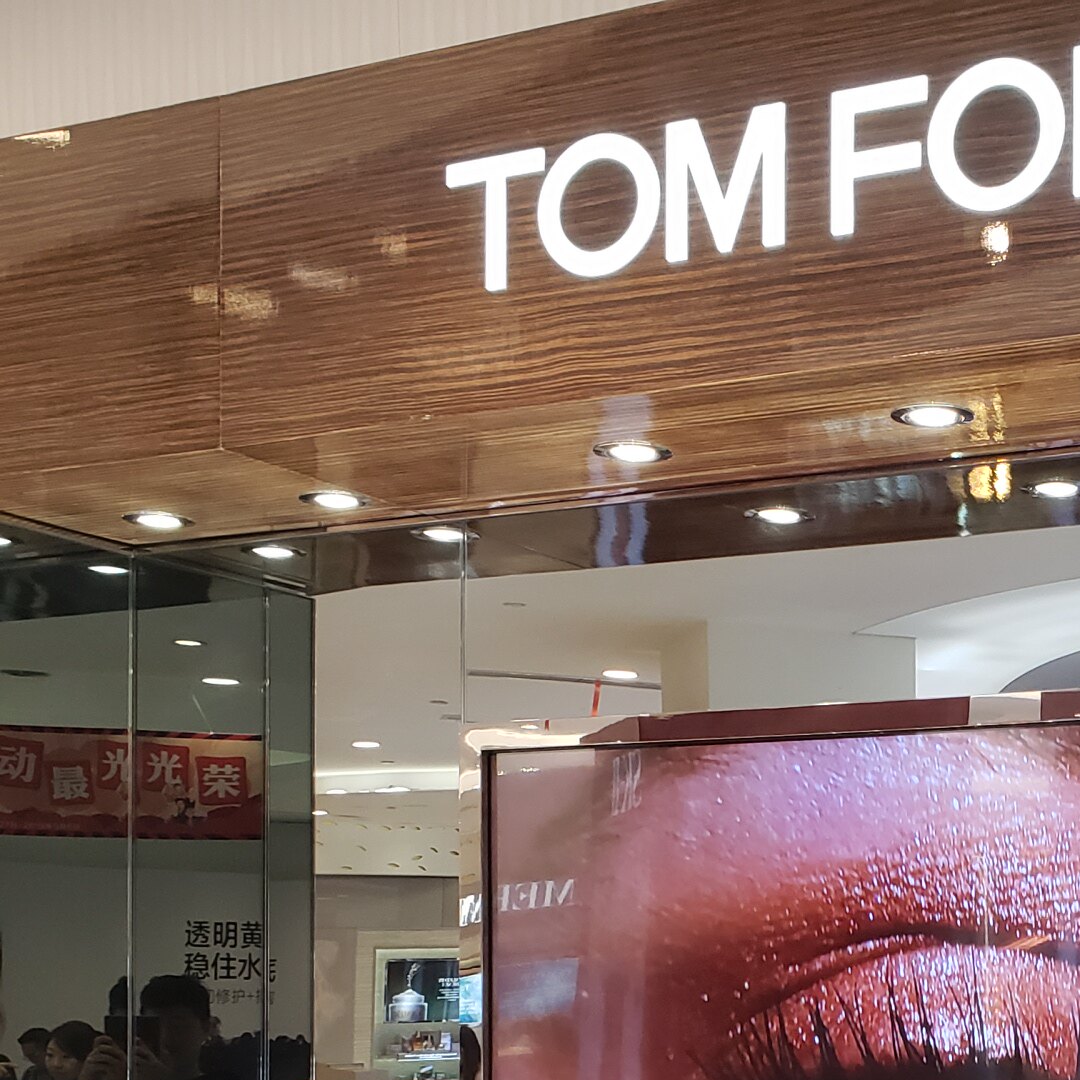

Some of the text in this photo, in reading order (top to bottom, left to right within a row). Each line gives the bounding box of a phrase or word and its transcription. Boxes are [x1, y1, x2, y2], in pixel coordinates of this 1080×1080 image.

[446, 102, 786, 291] TOM
[185, 920, 262, 949] 透明黄
